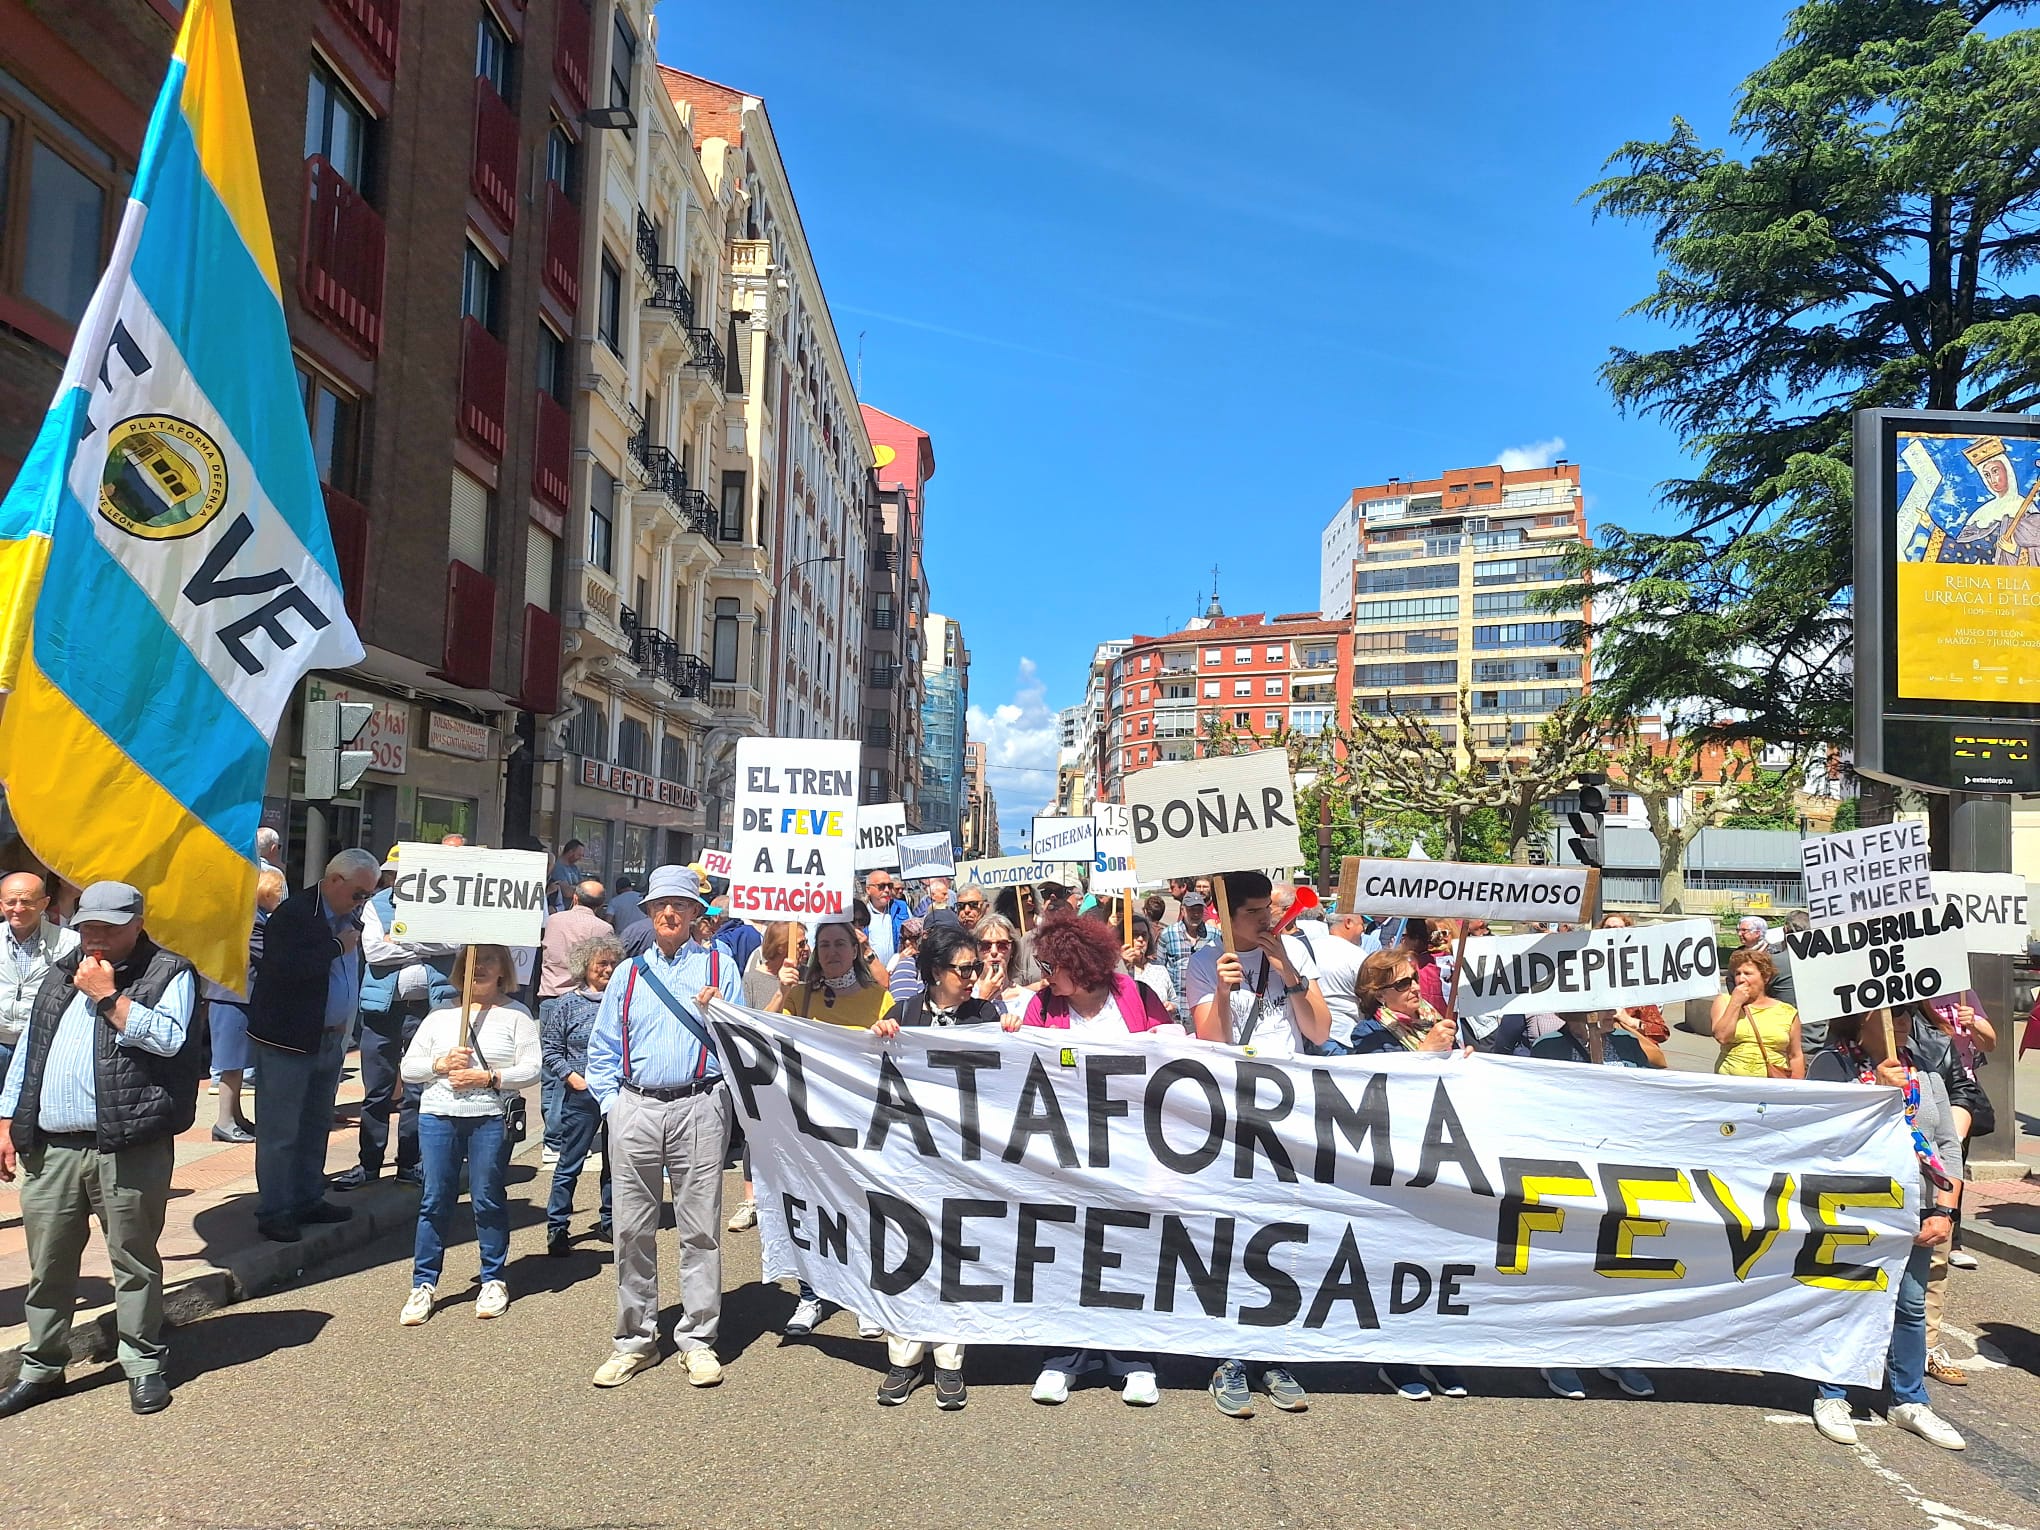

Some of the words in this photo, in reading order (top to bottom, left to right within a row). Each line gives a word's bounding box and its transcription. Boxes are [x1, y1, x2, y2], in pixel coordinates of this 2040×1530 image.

[129, 421, 214, 459] PLATAFORMA
[199, 464, 222, 517] DEFENSA
[1924, 590, 1984, 605] URRACA
[1946, 576, 1991, 590] REINA
[1997, 578, 2031, 591] ELLA
[1944, 636, 1977, 646] MARZO
[1993, 638, 2019, 648] JUNIO
[1955, 627, 1985, 637] MUSEO
[1986, 629, 1998, 637] DE
[747, 766, 780, 793] EL
[784, 767, 853, 796] TREN
[1972, 776, 2014, 786] exteriorplus
[742, 807, 773, 832] DE
[780, 808, 843, 837] FEVE
[1103, 805, 1129, 827] 15
[1131, 786, 1297, 844] BOÑAR
[900, 839, 953, 873] VILLAQUILAMBRE
[1034, 823, 1093, 856] CISTIERNA
[1803, 837, 1855, 868] SIN
[1862, 824, 1927, 857] FEVE
[753, 846, 775, 873] A
[786, 848, 825, 876] LA
[393, 868, 546, 911] CISTIERNA
[733, 881, 843, 914] ESTACIÓN
[1364, 875, 1582, 906] CAMPOHERMOSO
[1806, 869, 1838, 893] LA
[1809, 893, 1846, 920] SE
[1850, 876, 1932, 913] MUERE
[1786, 902, 1964, 961] VALDERILLA
[1461, 934, 1717, 998] VALDEPIÉLAGO
[1869, 944, 1906, 978] DE
[1832, 967, 1942, 1014] TORIO
[710, 1021, 1495, 1198] PLATAFORMA
[782, 1191, 848, 1266] EN
[865, 1190, 1381, 1330] DEFENSA
[1388, 1261, 1476, 1317] DE
[1495, 1157, 1906, 1293] FEVE
